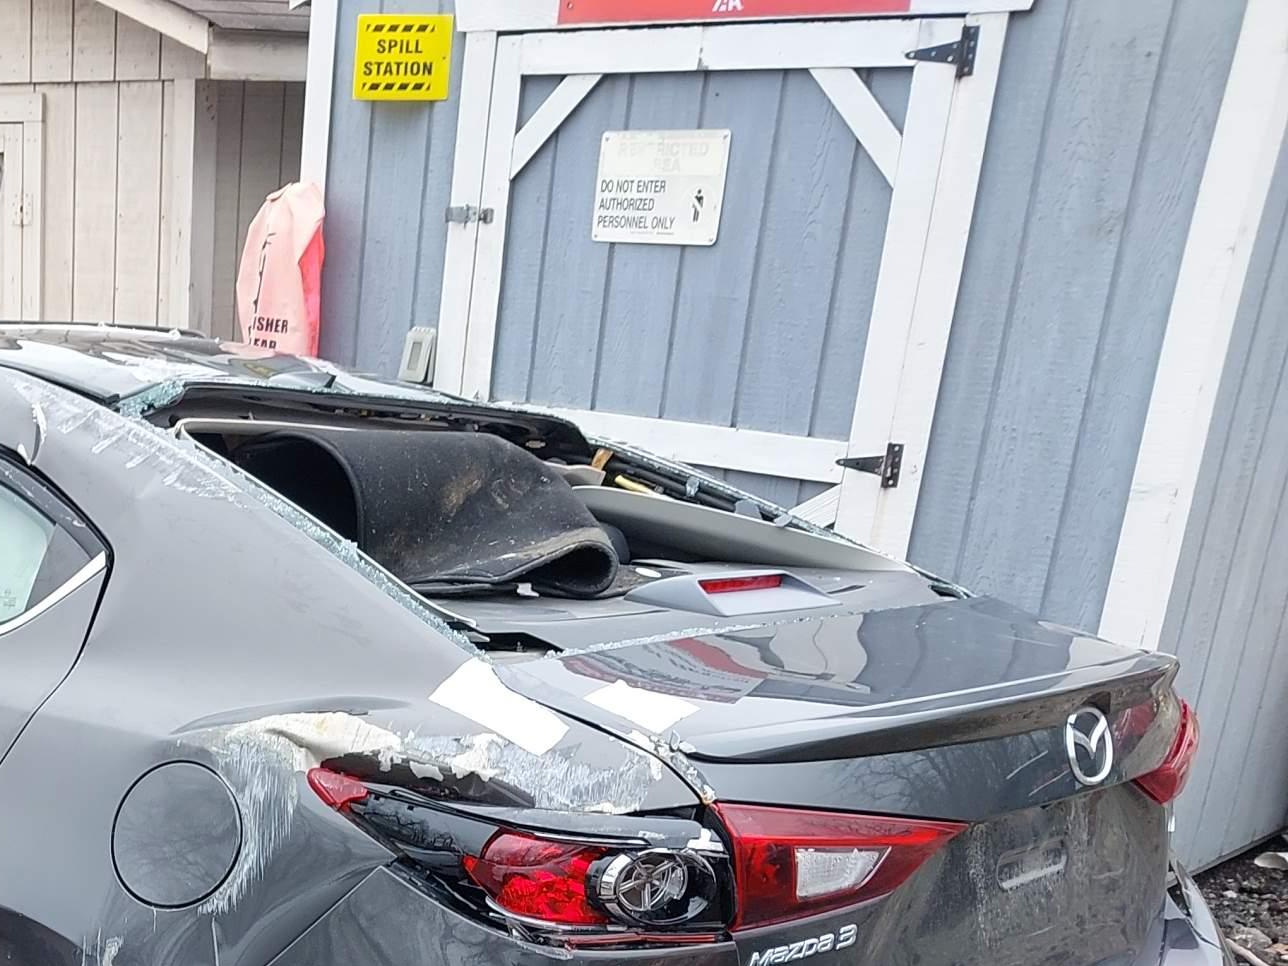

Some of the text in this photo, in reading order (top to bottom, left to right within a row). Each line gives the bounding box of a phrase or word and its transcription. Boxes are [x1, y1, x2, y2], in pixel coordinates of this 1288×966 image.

[377, 39, 423, 54] SPILL
[363, 61, 433, 76] STATION
[600, 179, 666, 193] DO NOT ENTER
[598, 198, 655, 211] AUTHORIZED
[596, 215, 675, 230] PERSONNEL ONLY
[836, 923, 858, 950] 3
